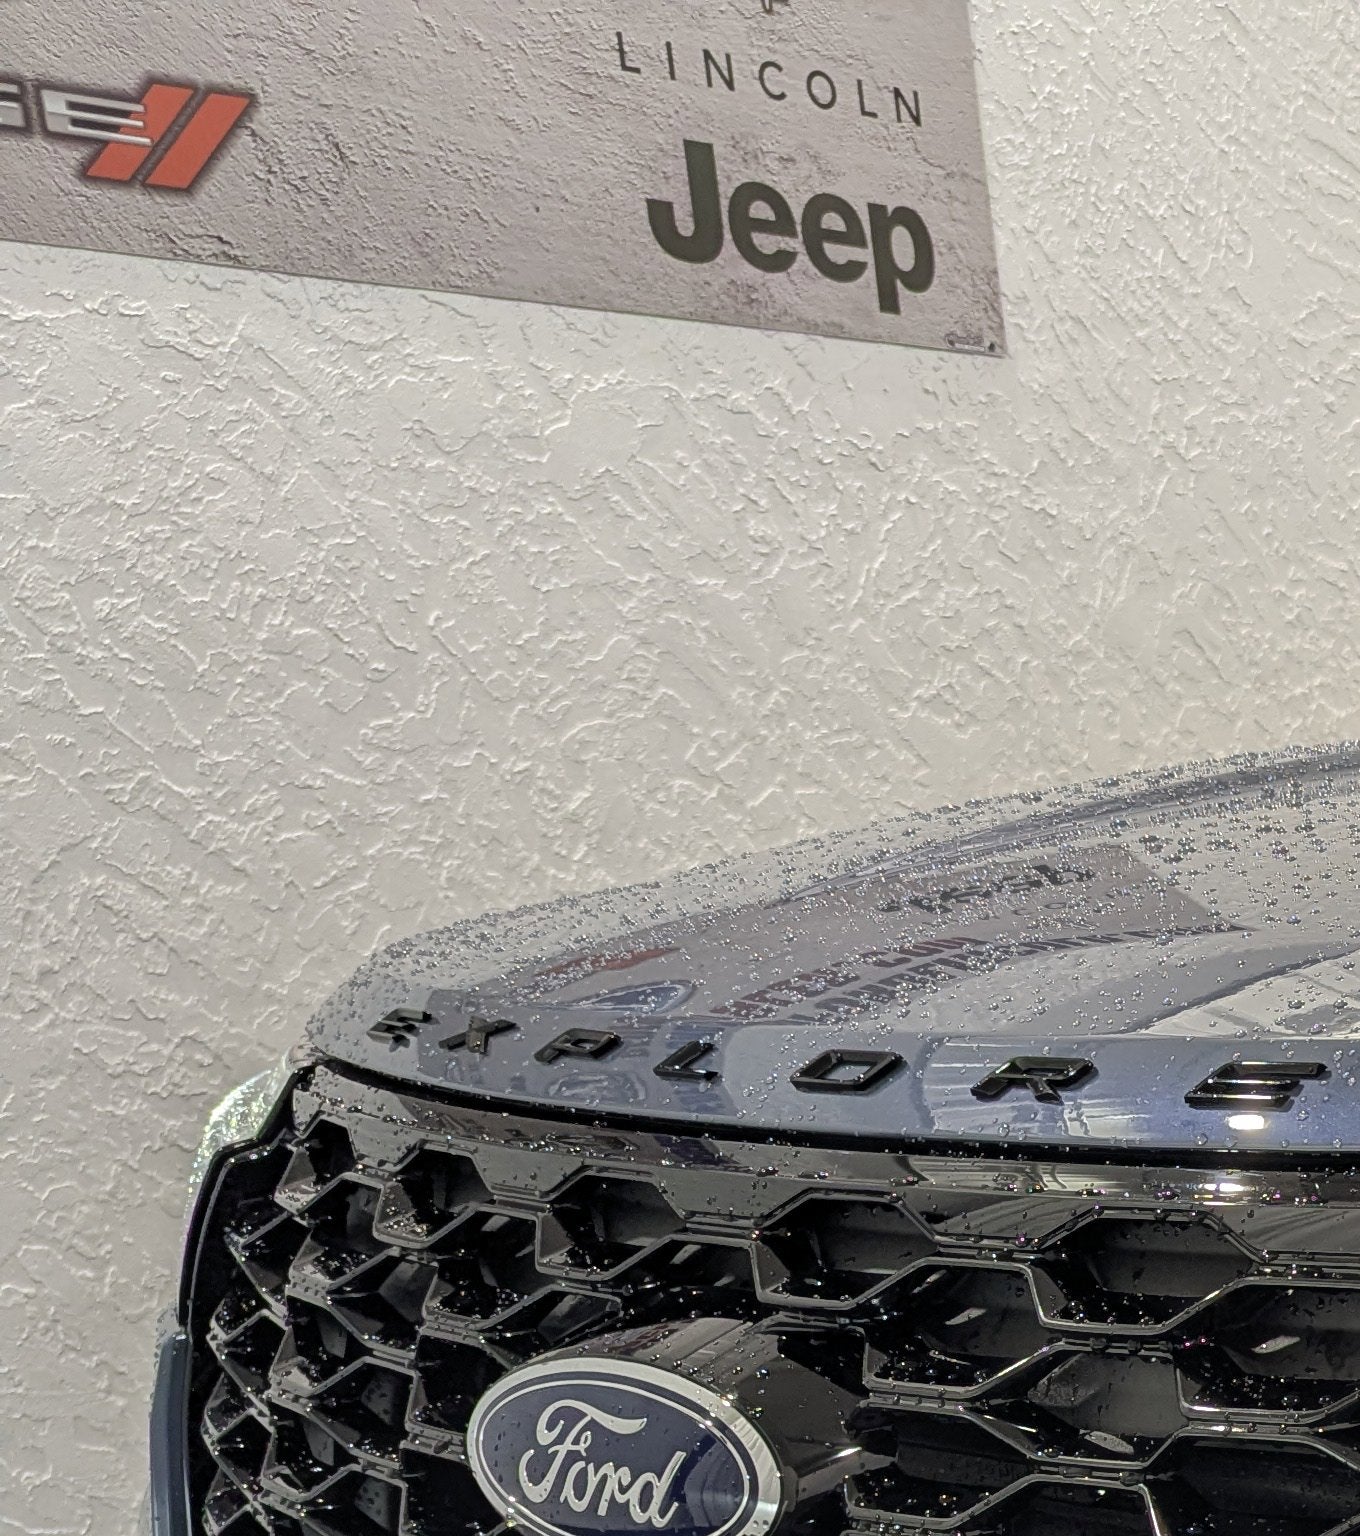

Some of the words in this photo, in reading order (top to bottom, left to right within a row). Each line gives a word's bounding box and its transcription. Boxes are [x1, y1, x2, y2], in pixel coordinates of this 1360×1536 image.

[615, 31, 922, 127] LINCOLN
[646, 139, 936, 315] Jeep
[519, 1399, 688, 1528] Ford
